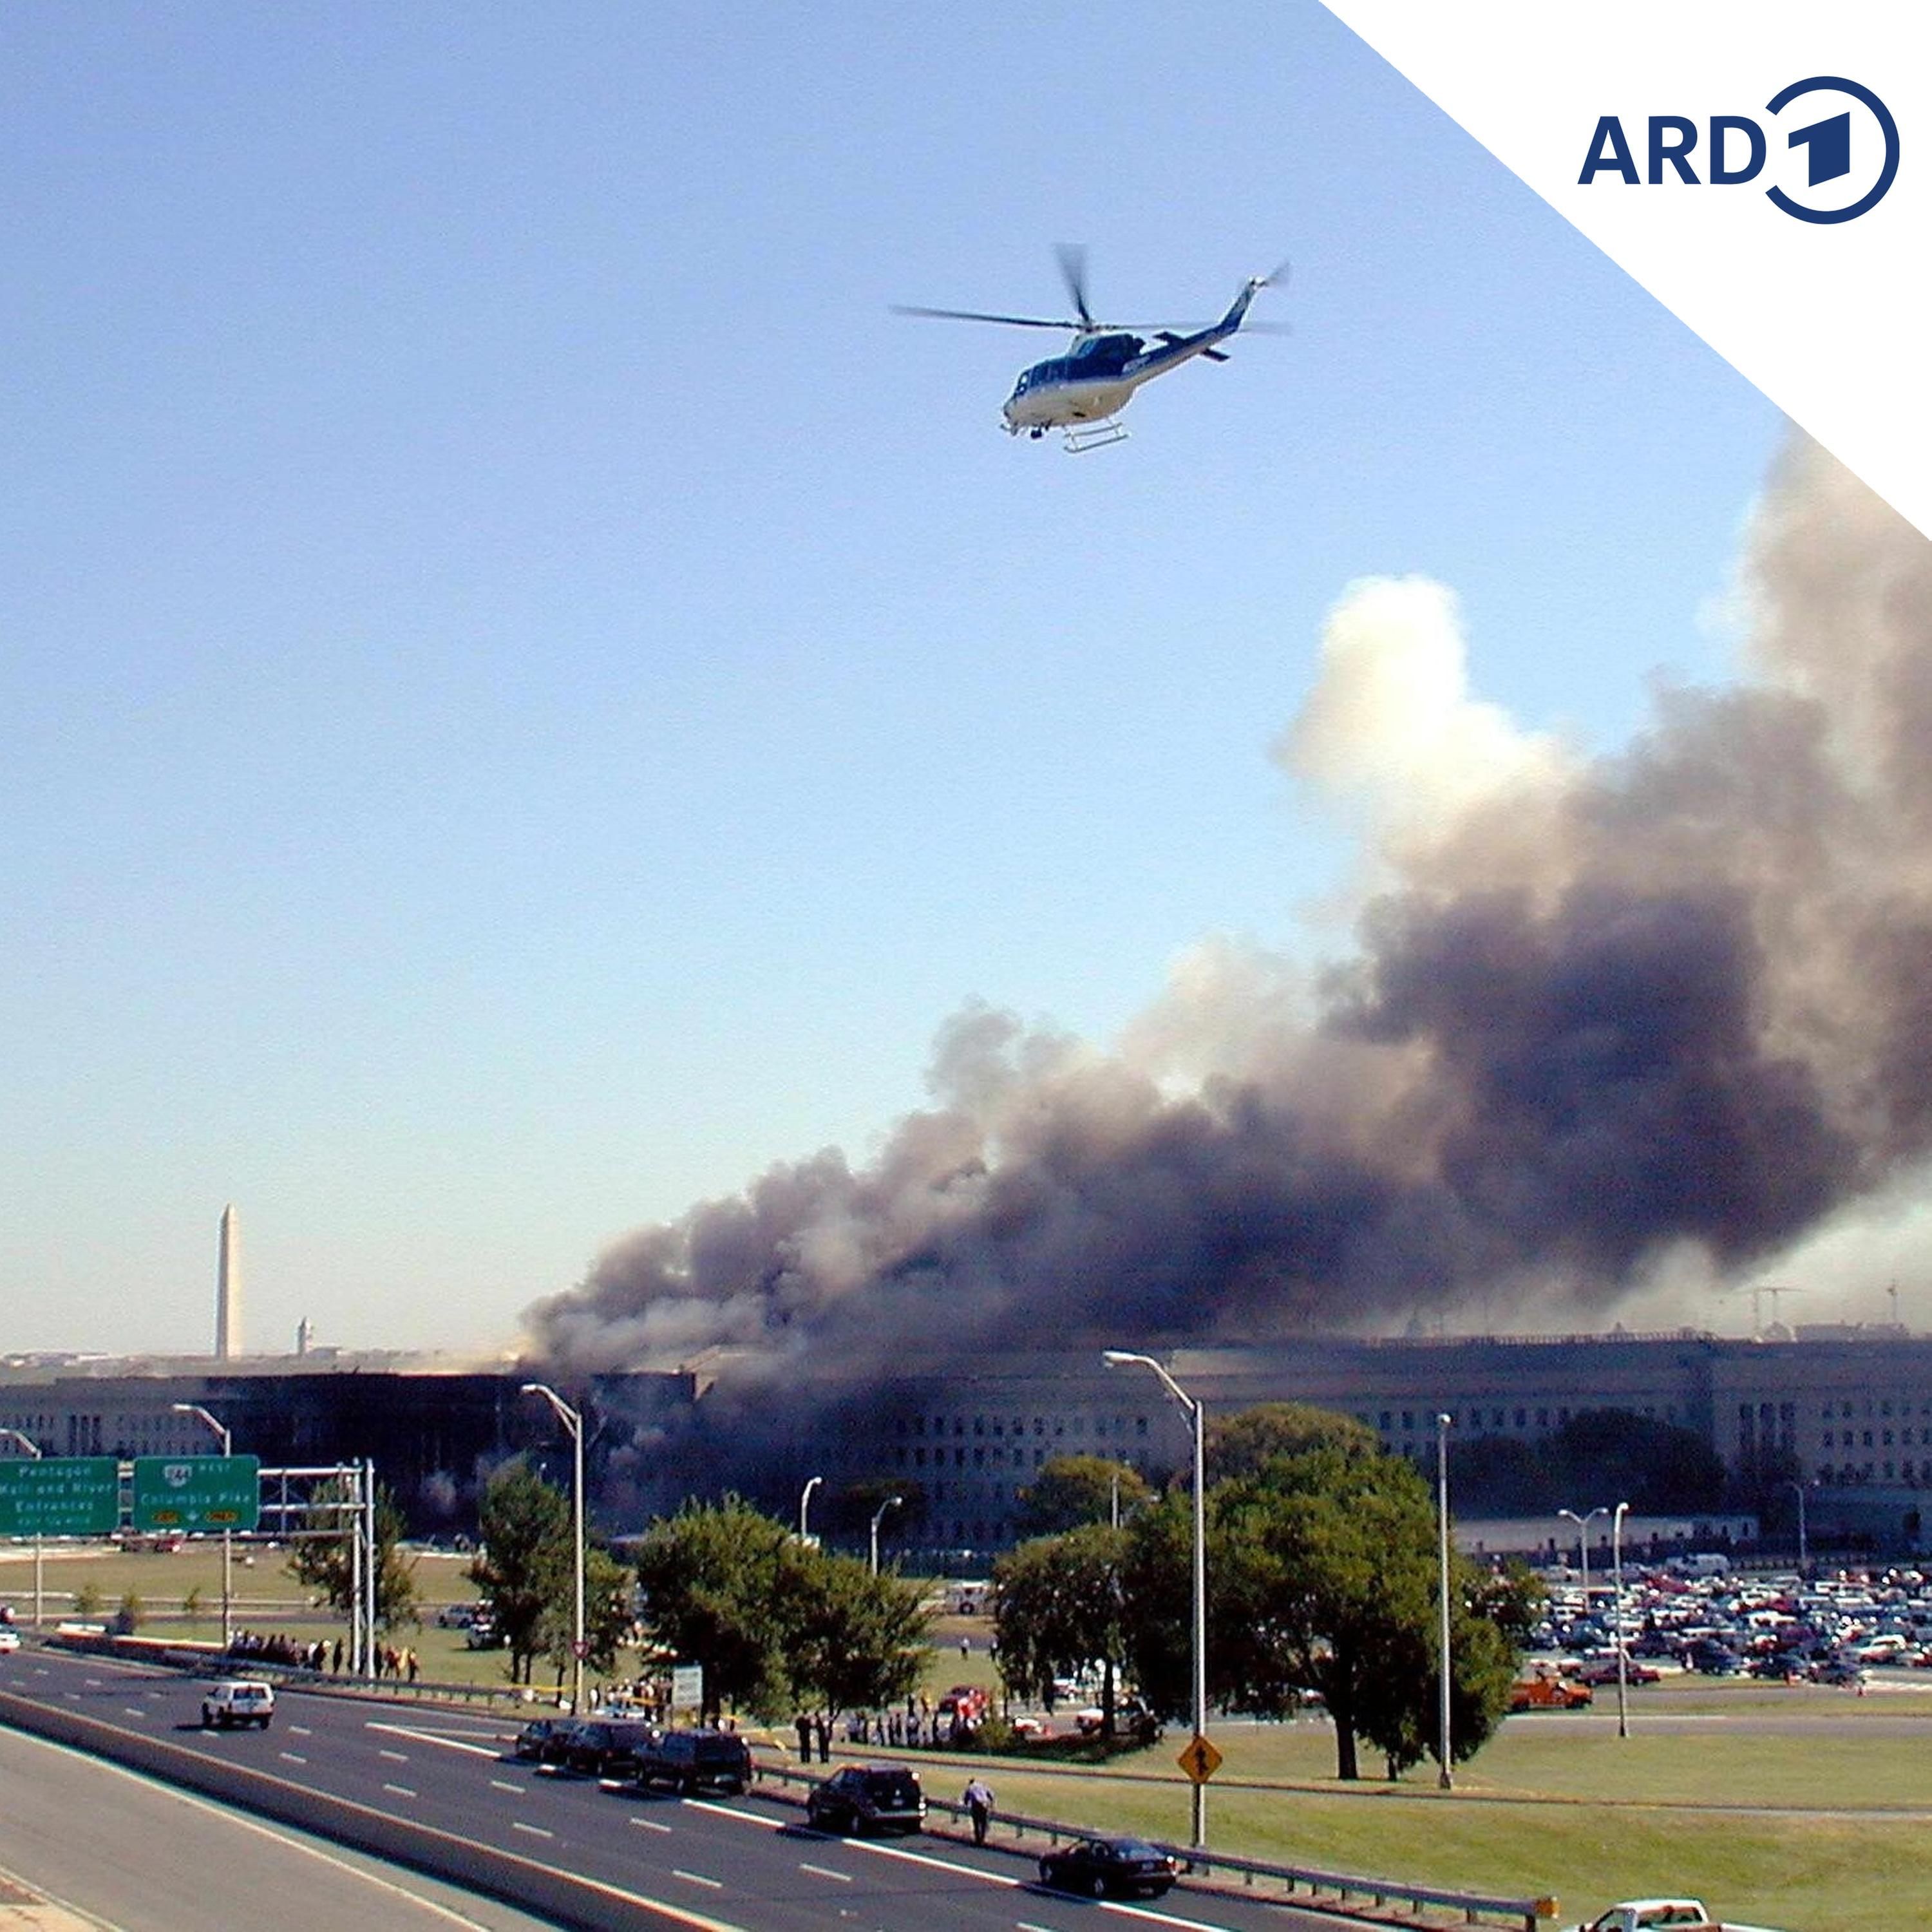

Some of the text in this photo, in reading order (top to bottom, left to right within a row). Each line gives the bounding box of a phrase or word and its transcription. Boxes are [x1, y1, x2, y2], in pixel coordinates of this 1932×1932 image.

[19, 1464, 91, 1478] Pentagon
[37, 1484, 64, 1495] and
[72, 1482, 112, 1495] River
[140, 1491, 251, 1506] Columbia Pike
